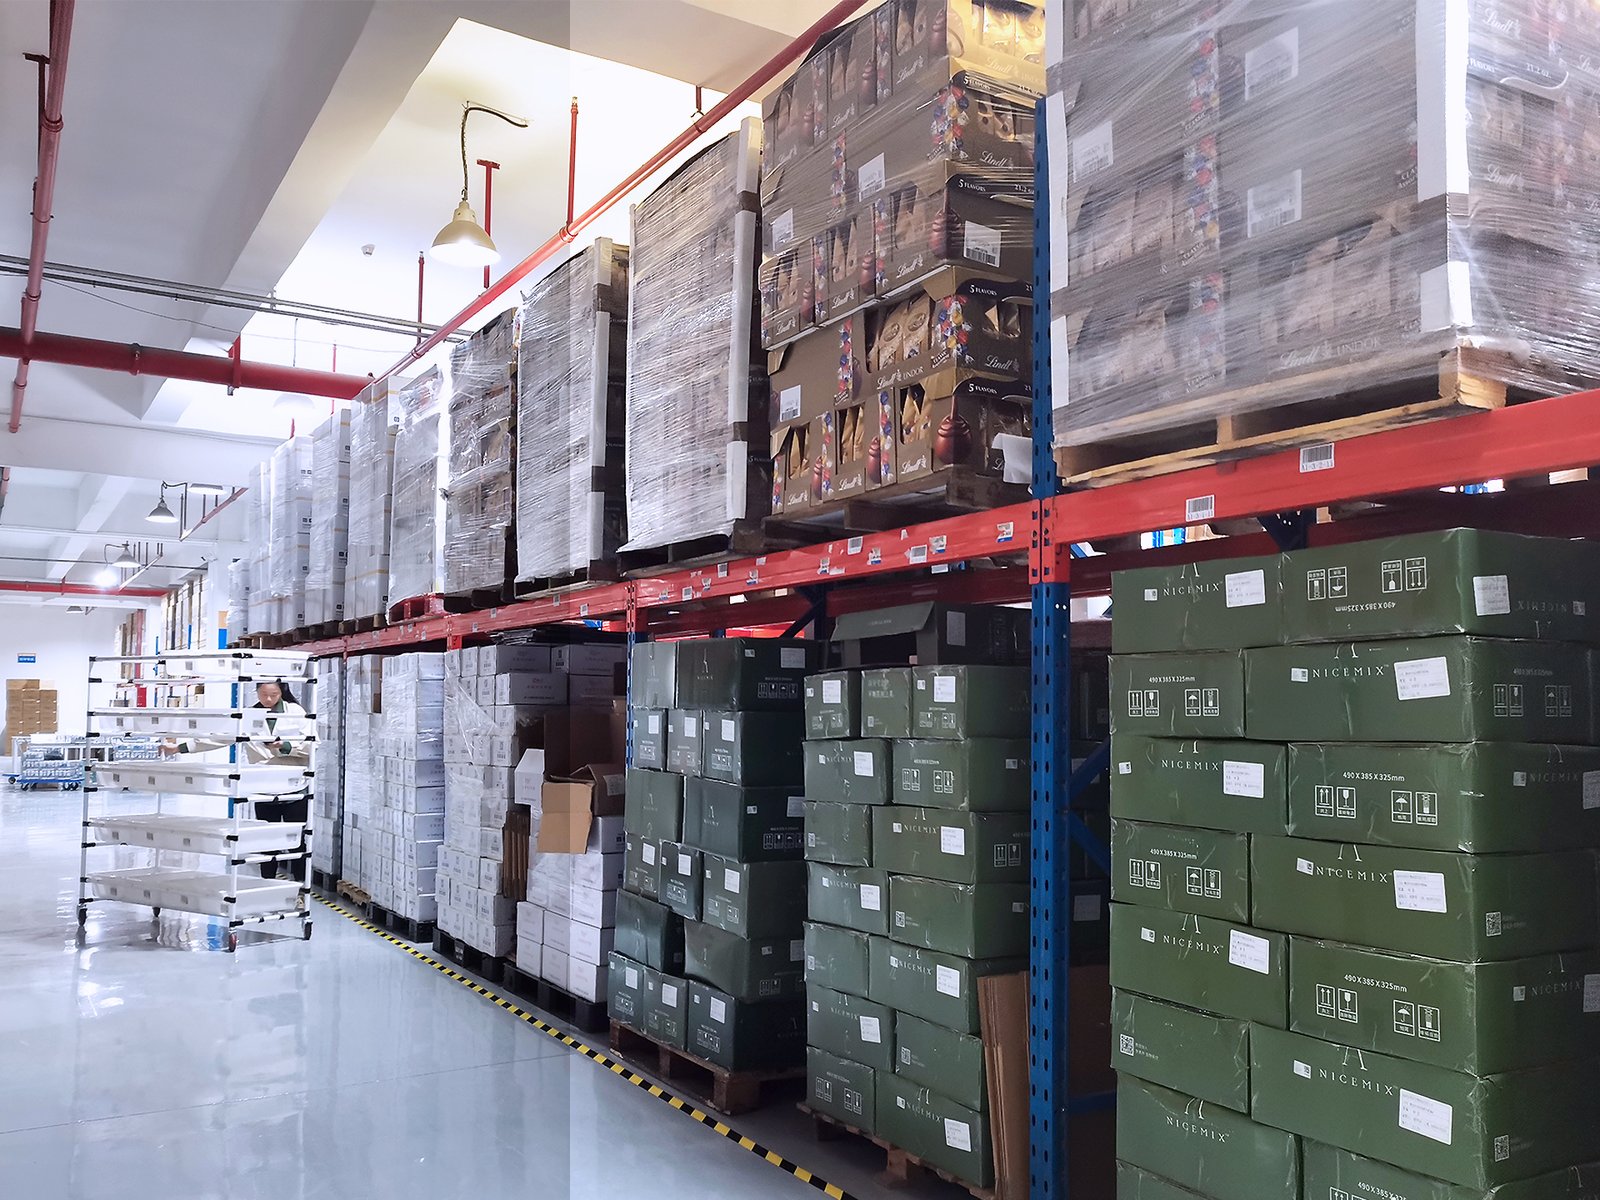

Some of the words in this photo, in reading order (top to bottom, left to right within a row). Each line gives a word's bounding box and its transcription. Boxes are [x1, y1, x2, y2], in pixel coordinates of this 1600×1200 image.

[981, 151, 1008, 168] Lindt
[958, 179, 965, 188] 5
[969, 284, 975, 294] 5
[975, 287, 998, 297] FLAVORS
[985, 354, 1013, 371] Lindt
[968, 383, 975, 393] 5
[975, 385, 998, 395] FLAVORS
[1163, 582, 1221, 597] NICEMIX
[1311, 666, 1385, 679] NICEMIX
[1160, 759, 1220, 772] NICEMIX
[903, 823, 938, 835] NICEMIX
[1316, 866, 1390, 884] NICEMIX
[1162, 934, 1221, 955] NICEMIX
[1317, 1067, 1394, 1097] NICEMIX
[1165, 1115, 1227, 1144] NICEMIX
